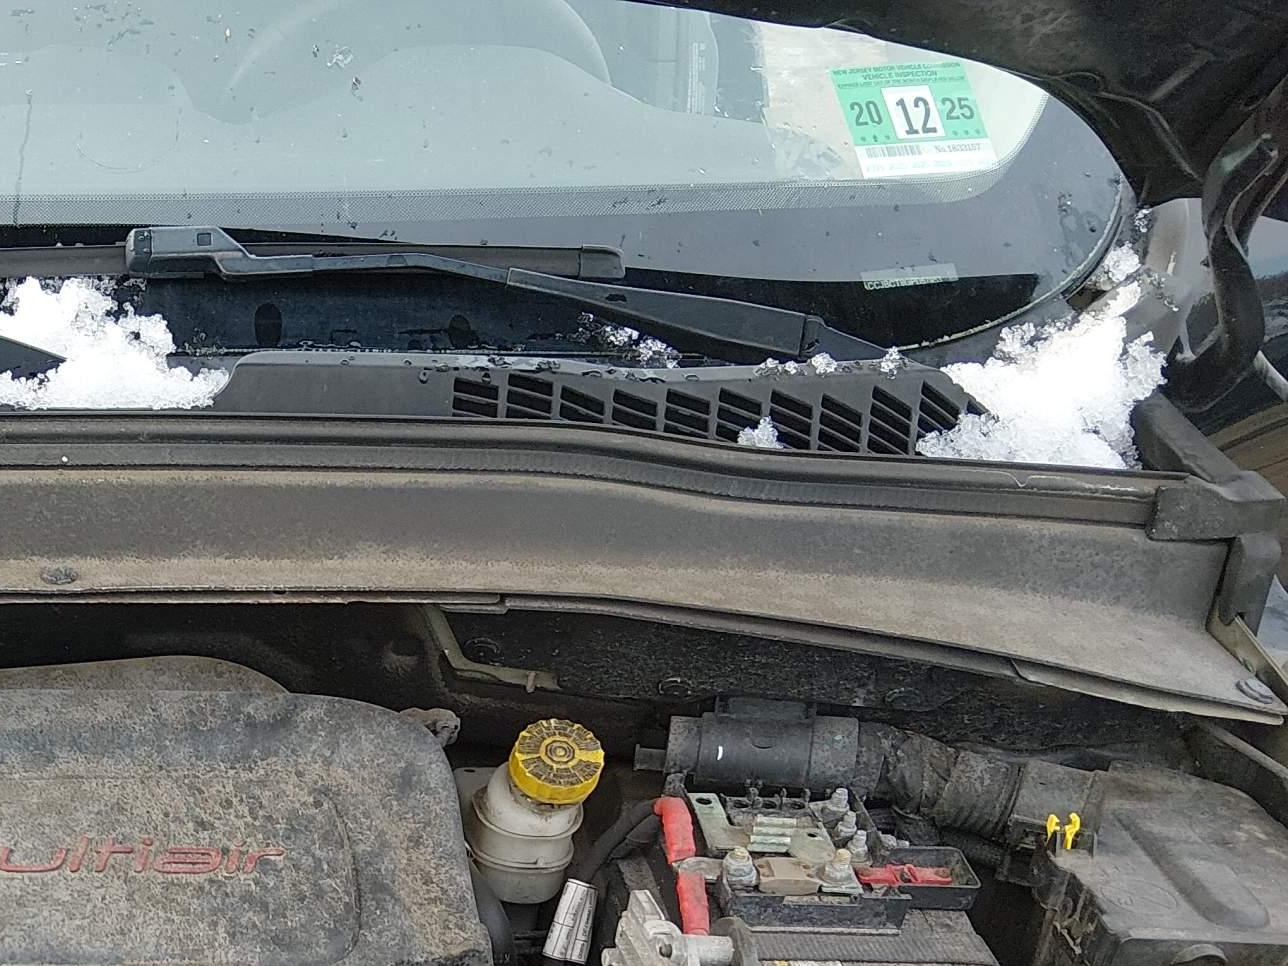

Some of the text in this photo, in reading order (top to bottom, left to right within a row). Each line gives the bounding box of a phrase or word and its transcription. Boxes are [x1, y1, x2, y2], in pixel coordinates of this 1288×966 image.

[862, 70, 938, 81] VEHICLE INSPECTION
[850, 97, 975, 135] 20 12 25
